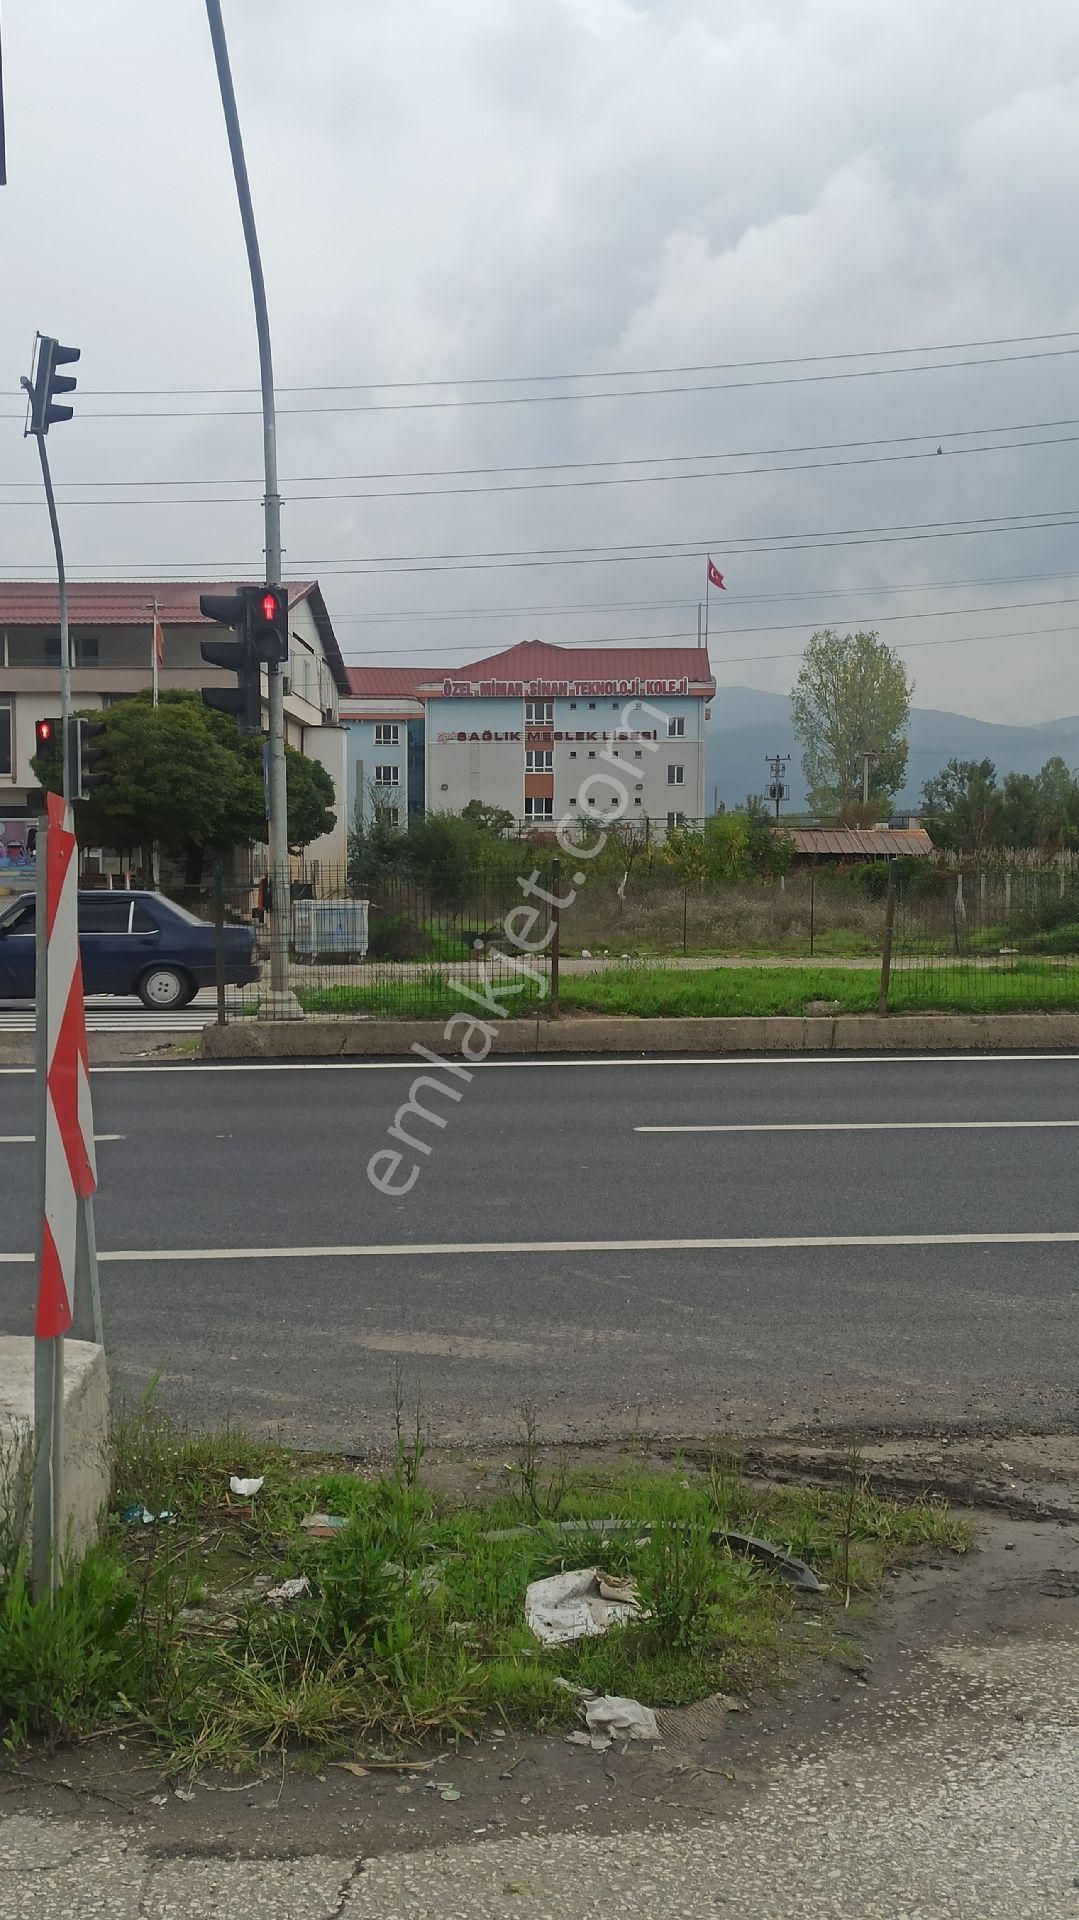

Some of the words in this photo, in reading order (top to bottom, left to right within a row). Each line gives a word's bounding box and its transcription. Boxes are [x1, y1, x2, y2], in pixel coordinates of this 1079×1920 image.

[442, 678, 475, 697] ÖZEL
[479, 678, 525, 697] MİMAR
[528, 678, 570, 697] SİNAN
[573, 677, 641, 697] TEKNOLOJİ
[644, 676, 689, 696] KOLEJİ
[457, 730, 521, 742] SAĞLIK
[528, 731, 598, 742] MESLEK
